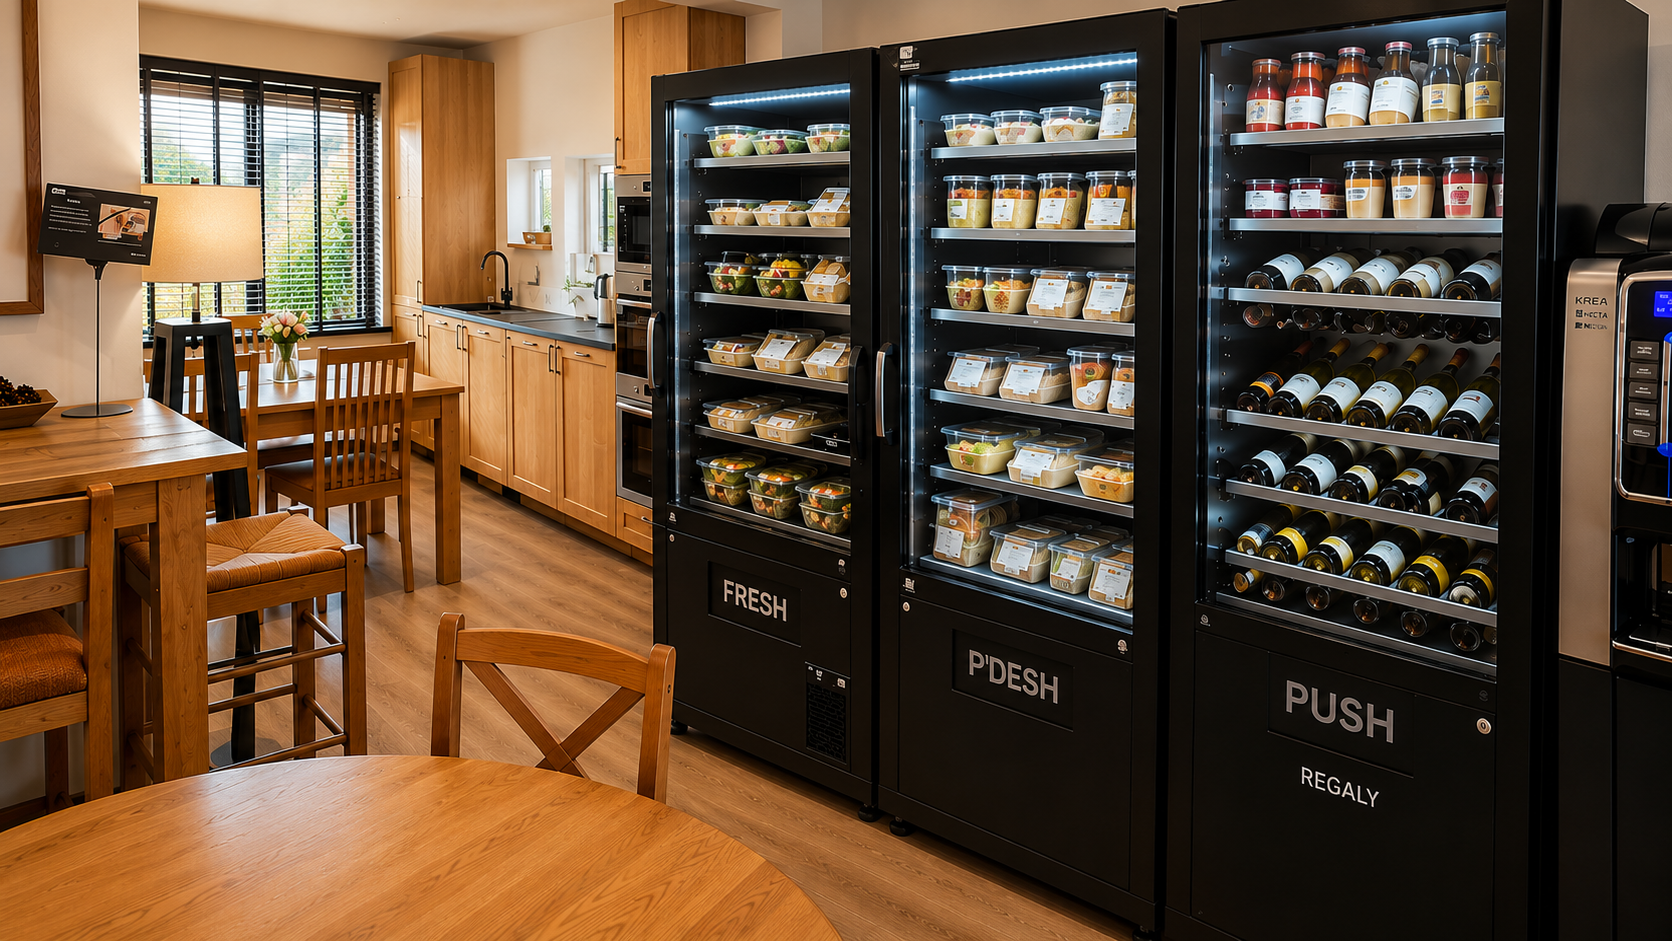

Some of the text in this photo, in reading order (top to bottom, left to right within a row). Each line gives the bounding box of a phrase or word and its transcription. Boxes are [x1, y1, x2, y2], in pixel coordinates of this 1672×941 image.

[1575, 296, 1608, 306] KREA
[723, 579, 787, 622] FRESH
[968, 649, 1059, 705] P'DESH
[1285, 679, 1394, 744] PUSH
[1301, 766, 1380, 808] REGALY
